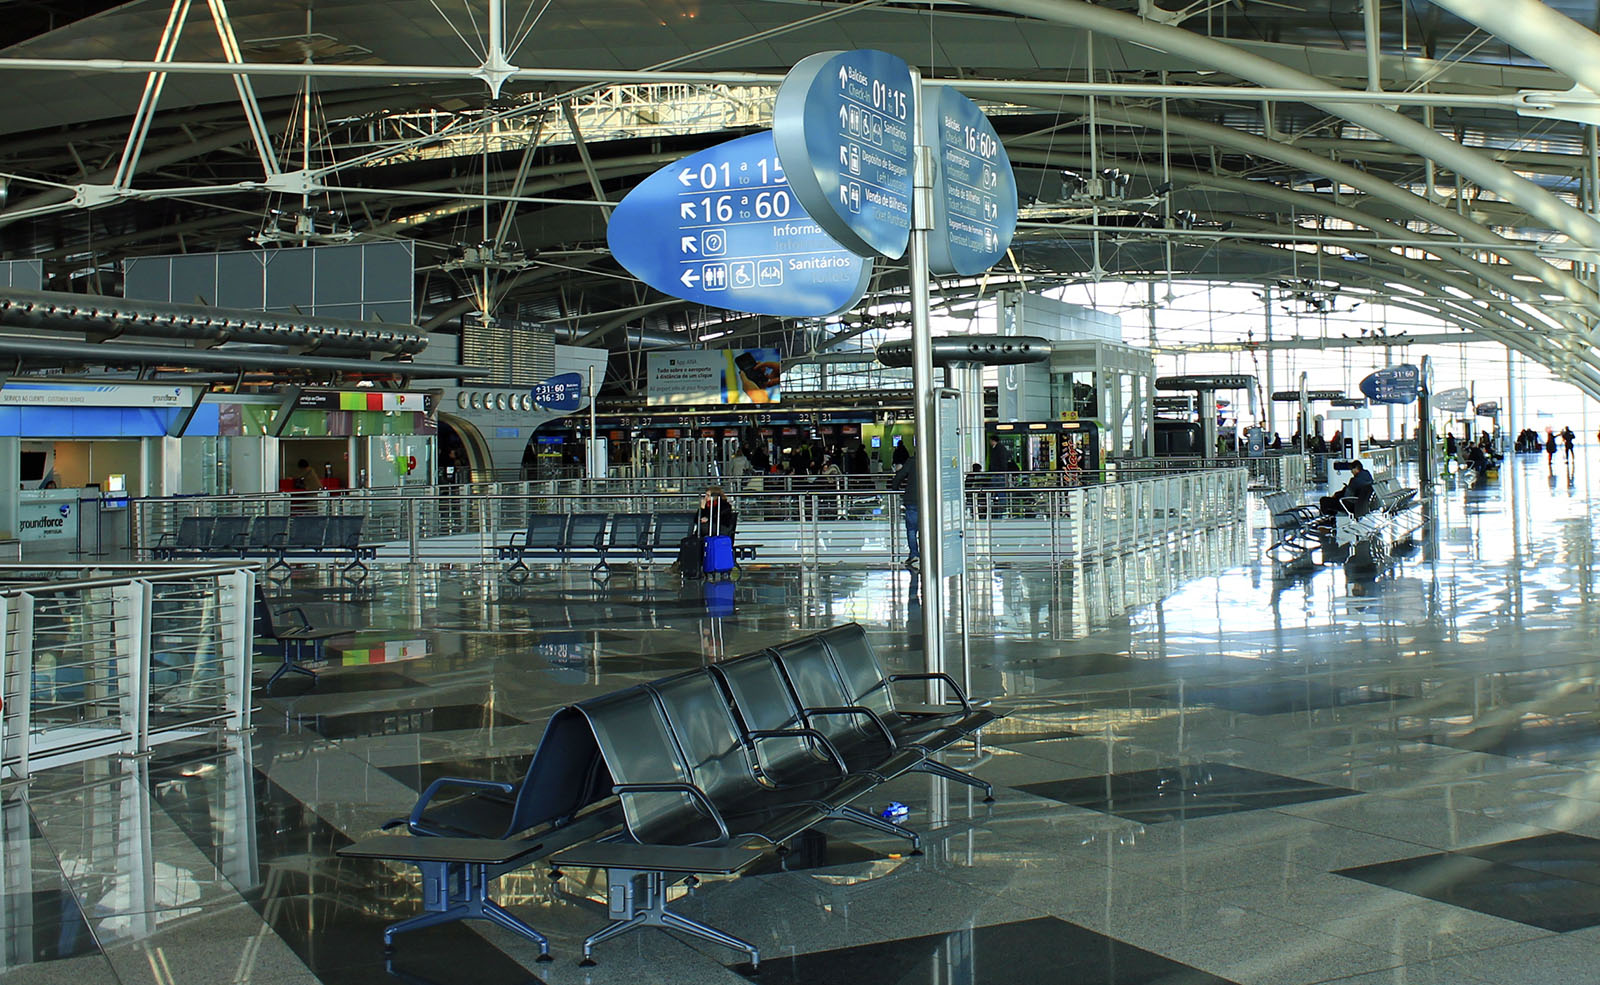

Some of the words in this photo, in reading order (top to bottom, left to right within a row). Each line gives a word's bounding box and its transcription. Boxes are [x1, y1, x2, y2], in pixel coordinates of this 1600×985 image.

[873, 79, 886, 111] 01
[893, 89, 907, 120] 15
[964, 125, 976, 152] 16
[980, 132, 991, 159] 60
[700, 162, 730, 189] 01
[740, 162, 748, 171] a
[757, 158, 788, 184] 15
[739, 176, 750, 185] to
[701, 195, 733, 222] 16
[740, 196, 749, 205] a
[755, 190, 790, 218] 60
[740, 210, 750, 220] to
[773, 224, 827, 237] Informa
[788, 256, 850, 270] Sanitários
[541, 386, 550, 394] 31
[554, 384, 565, 392] 60
[542, 394, 551, 402] 16
[555, 392, 565, 402] 30
[642, 417, 652, 426] 37
[760, 414, 771, 423] 33
[822, 413, 832, 422] 31
[20, 516, 64, 532] groundforce
